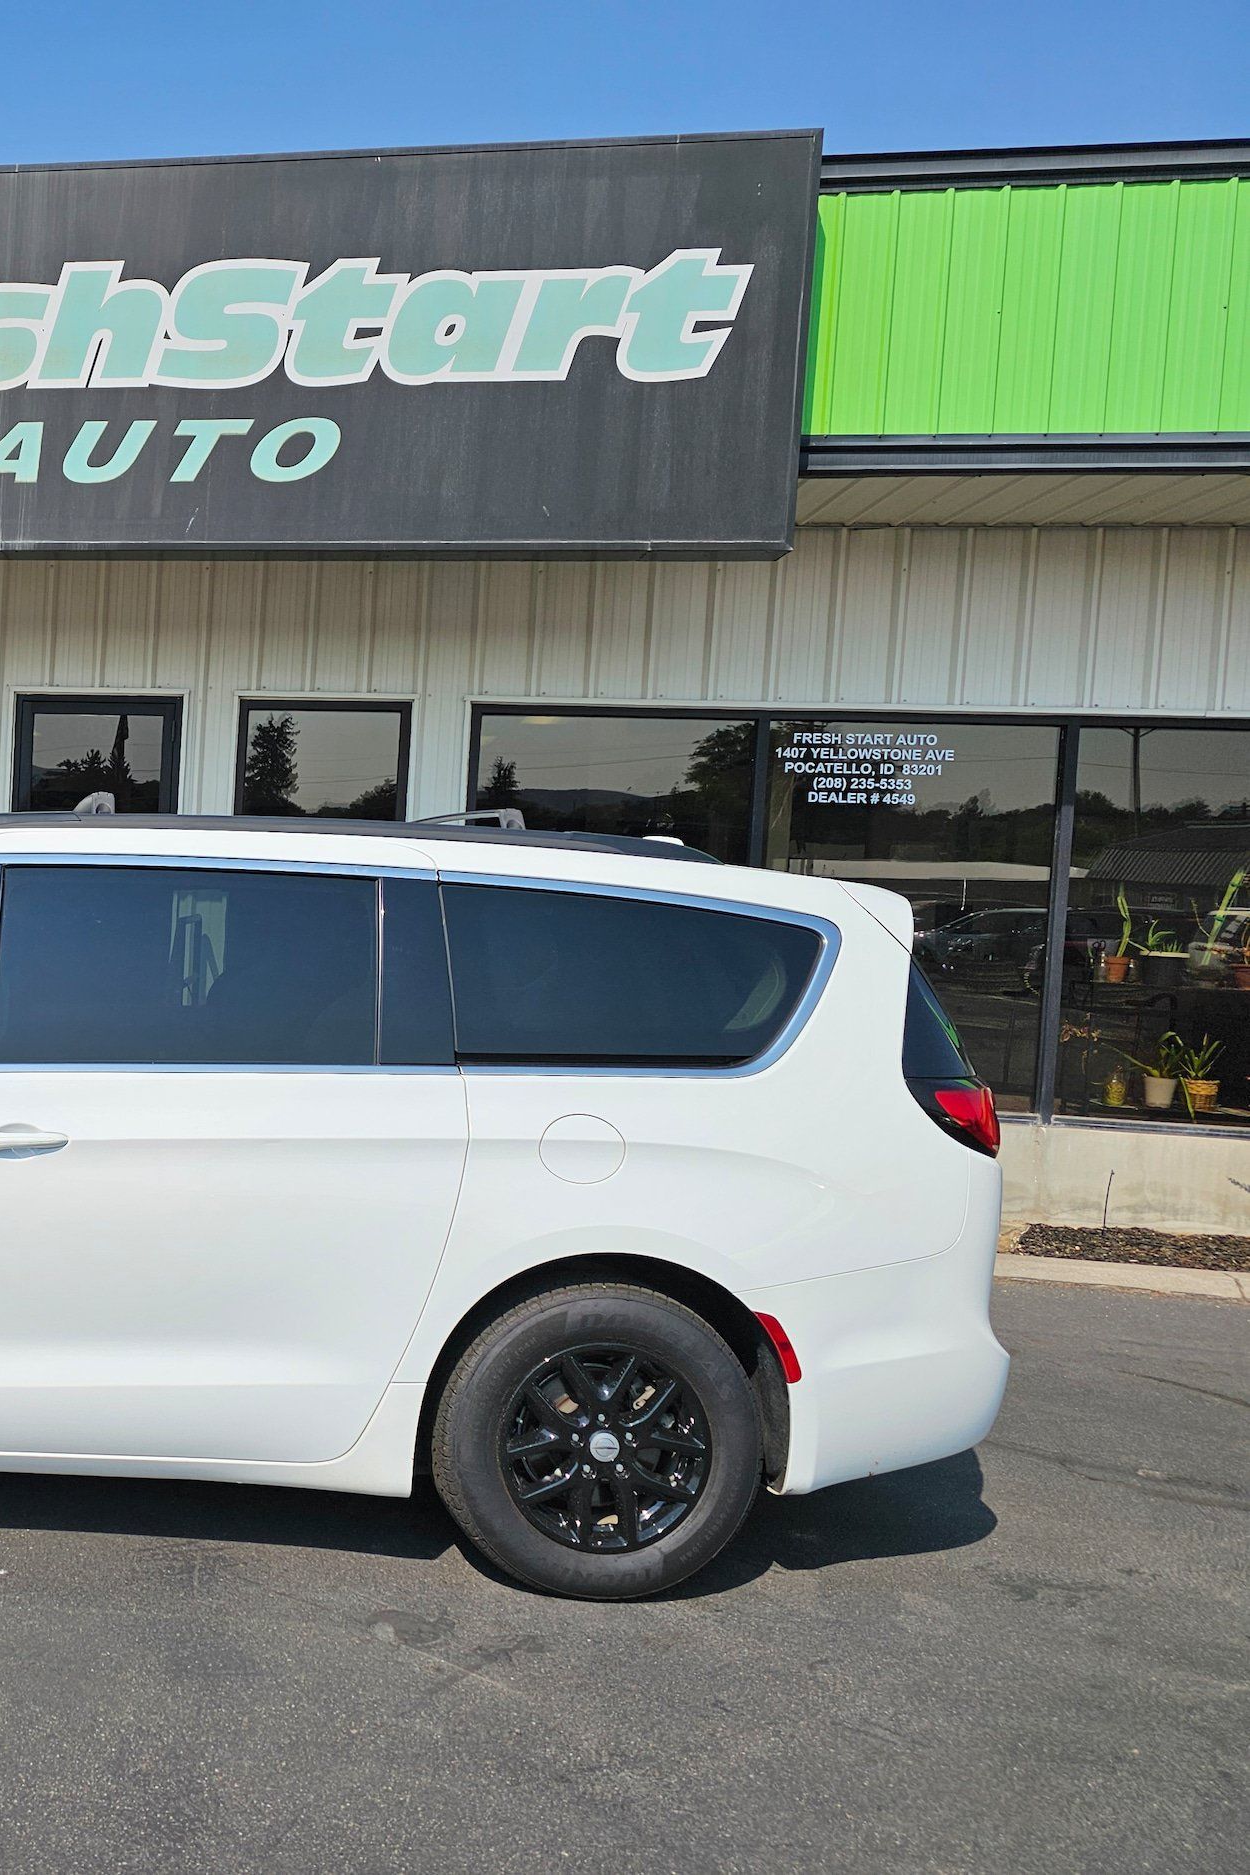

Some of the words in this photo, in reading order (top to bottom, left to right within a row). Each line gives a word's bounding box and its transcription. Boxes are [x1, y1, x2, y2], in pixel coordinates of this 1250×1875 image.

[793, 733, 842, 745] FRESH
[846, 734, 893, 745] START
[896, 734, 938, 746] AUTO
[775, 748, 806, 759] 1407
[811, 749, 921, 760] YELLOWSTONE
[925, 750, 955, 761] AVE
[784, 762, 875, 776] POCATELLO,
[880, 764, 894, 775] ID
[902, 764, 942, 775] 83201
[813, 778, 847, 791] (208)
[850, 779, 912, 790] 235-5353
[808, 792, 867, 804] DEALER
[870, 793, 880, 804] #
[882, 793, 916, 805] 4549
